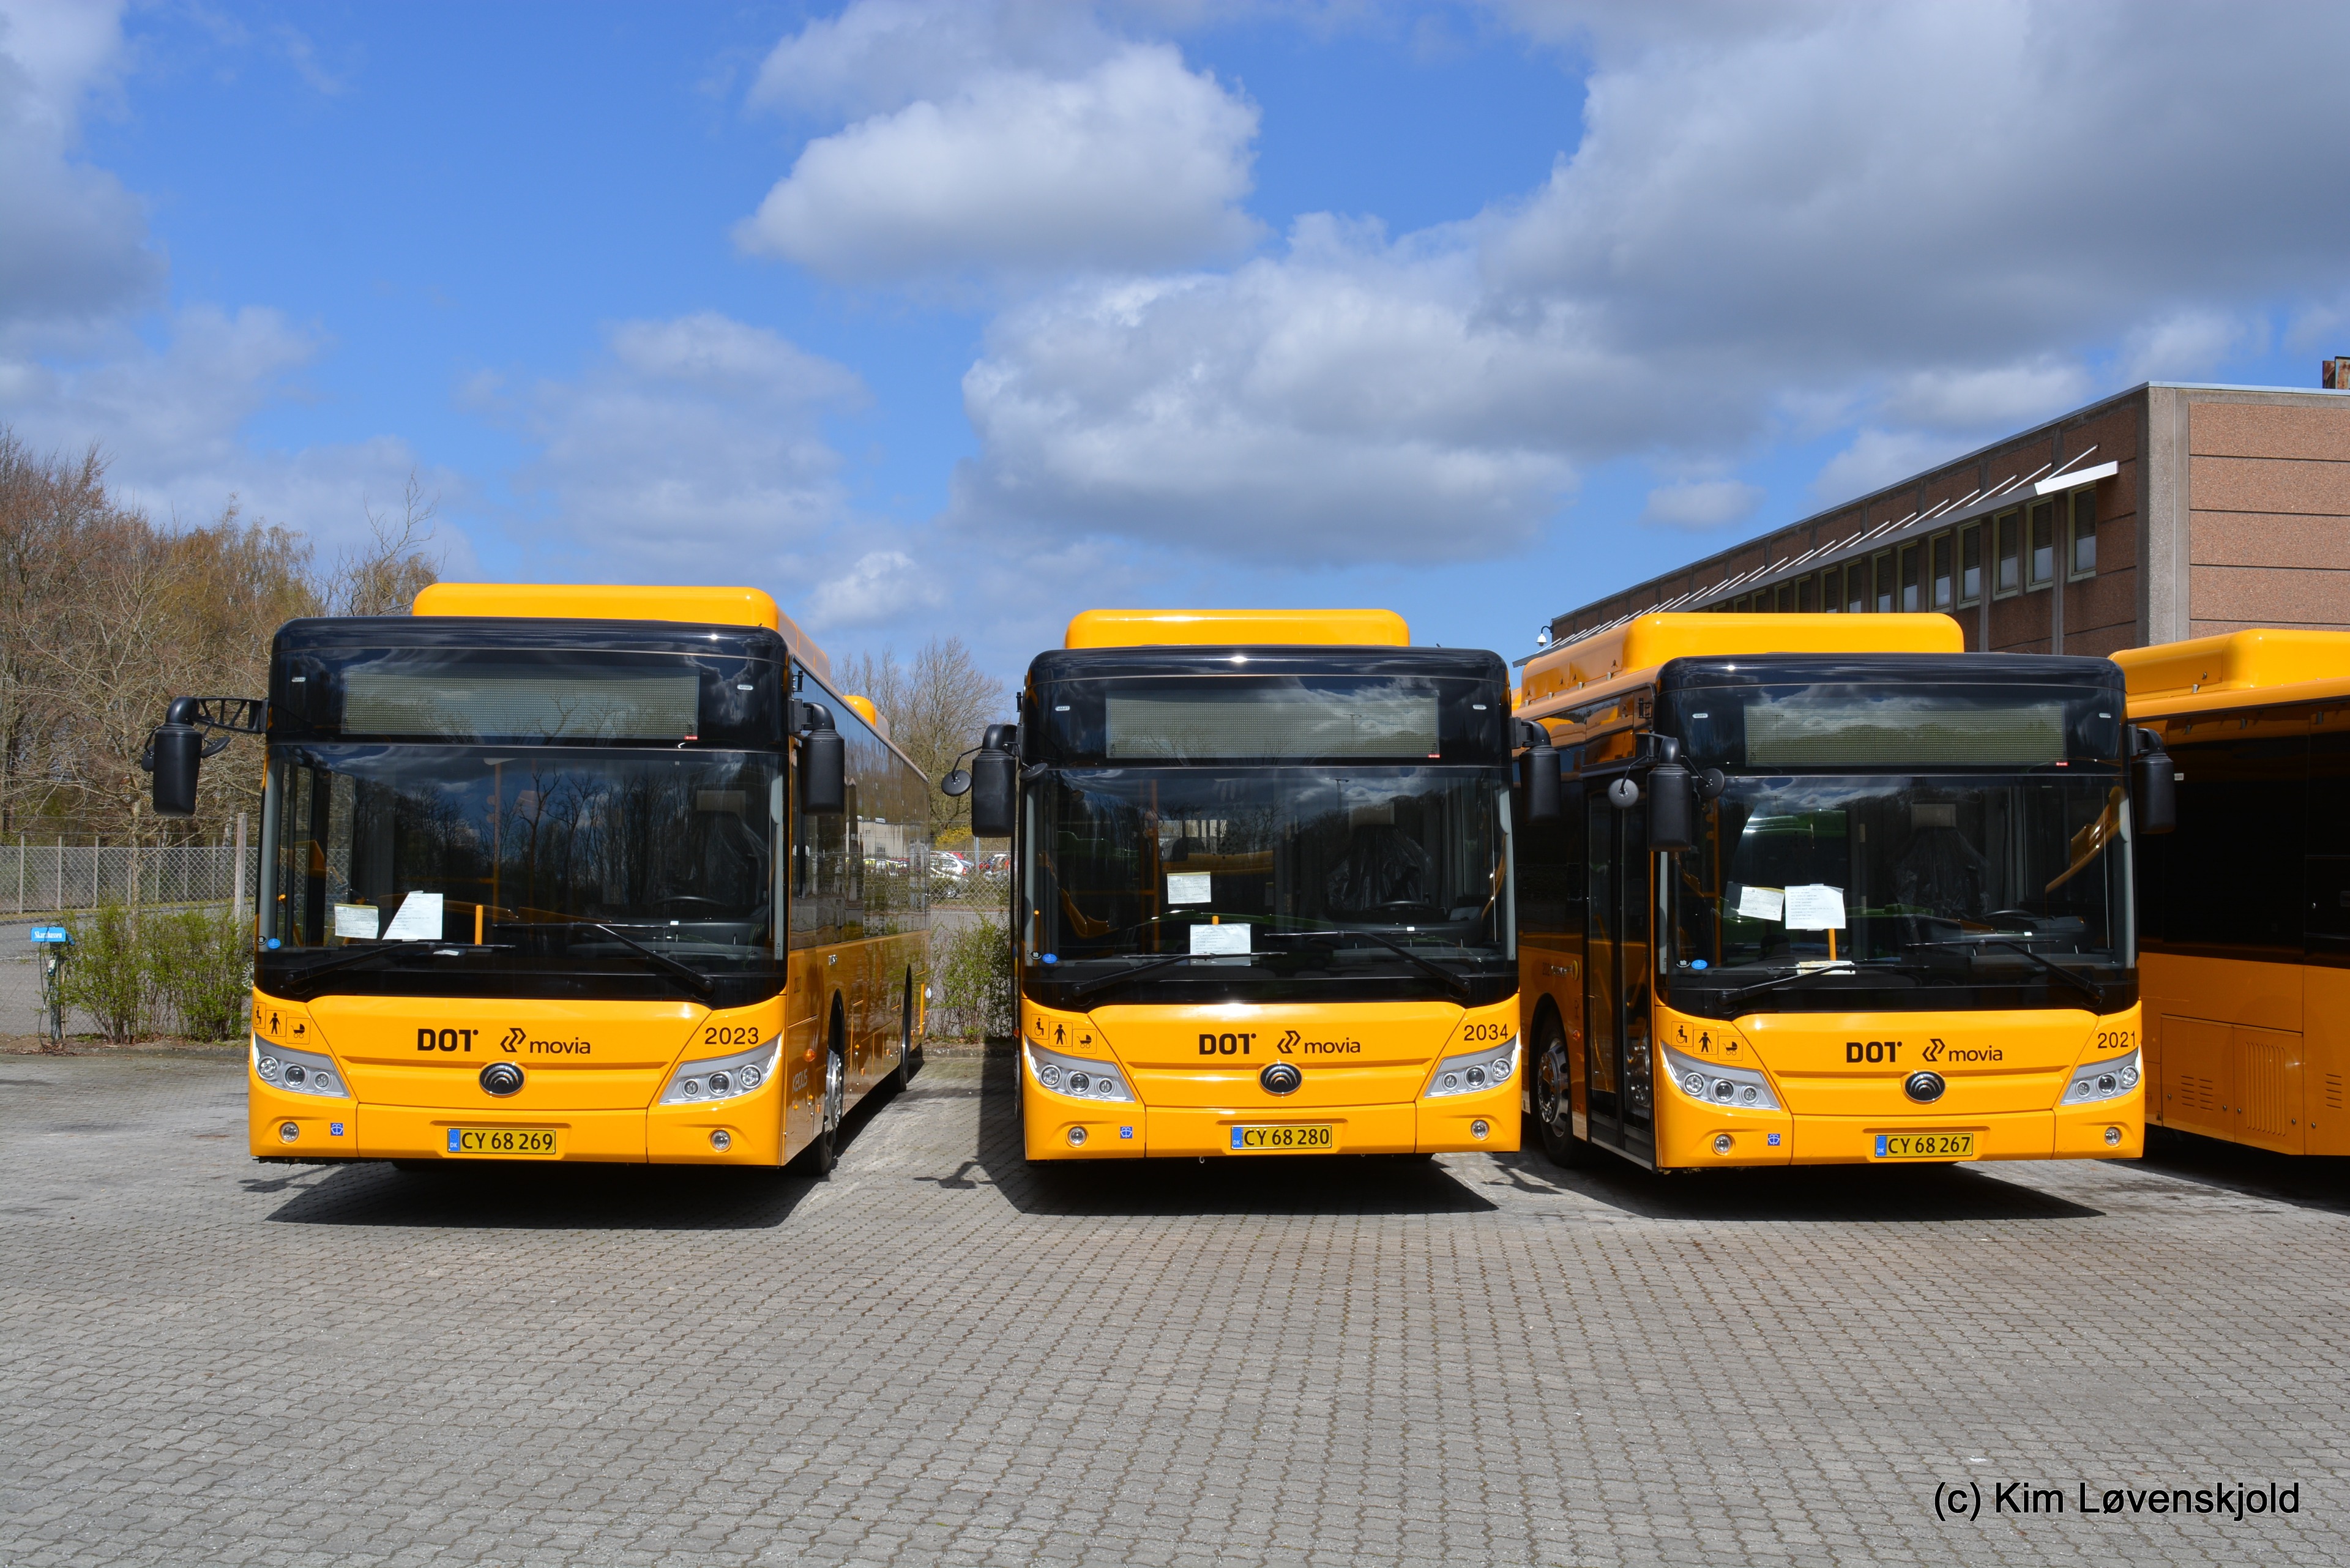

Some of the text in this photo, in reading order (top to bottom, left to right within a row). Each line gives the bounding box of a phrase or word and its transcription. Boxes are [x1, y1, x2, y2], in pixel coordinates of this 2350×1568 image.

[417, 1028, 479, 1052] DOT
[704, 1027, 759, 1046] 2023
[1463, 1023, 1509, 1042] 2034
[2097, 1031, 2137, 1049] 2021
[529, 1037, 591, 1055] movia
[1199, 1033, 1257, 1055] DOT
[1304, 1037, 1360, 1054] movia
[1846, 1041, 1903, 1063] DOT
[1949, 1045, 2003, 1062] movia
[461, 1132, 553, 1151] CY 68 269
[1244, 1129, 1329, 1146] CY 68 280
[1888, 1136, 1971, 1154] CY 68 267
